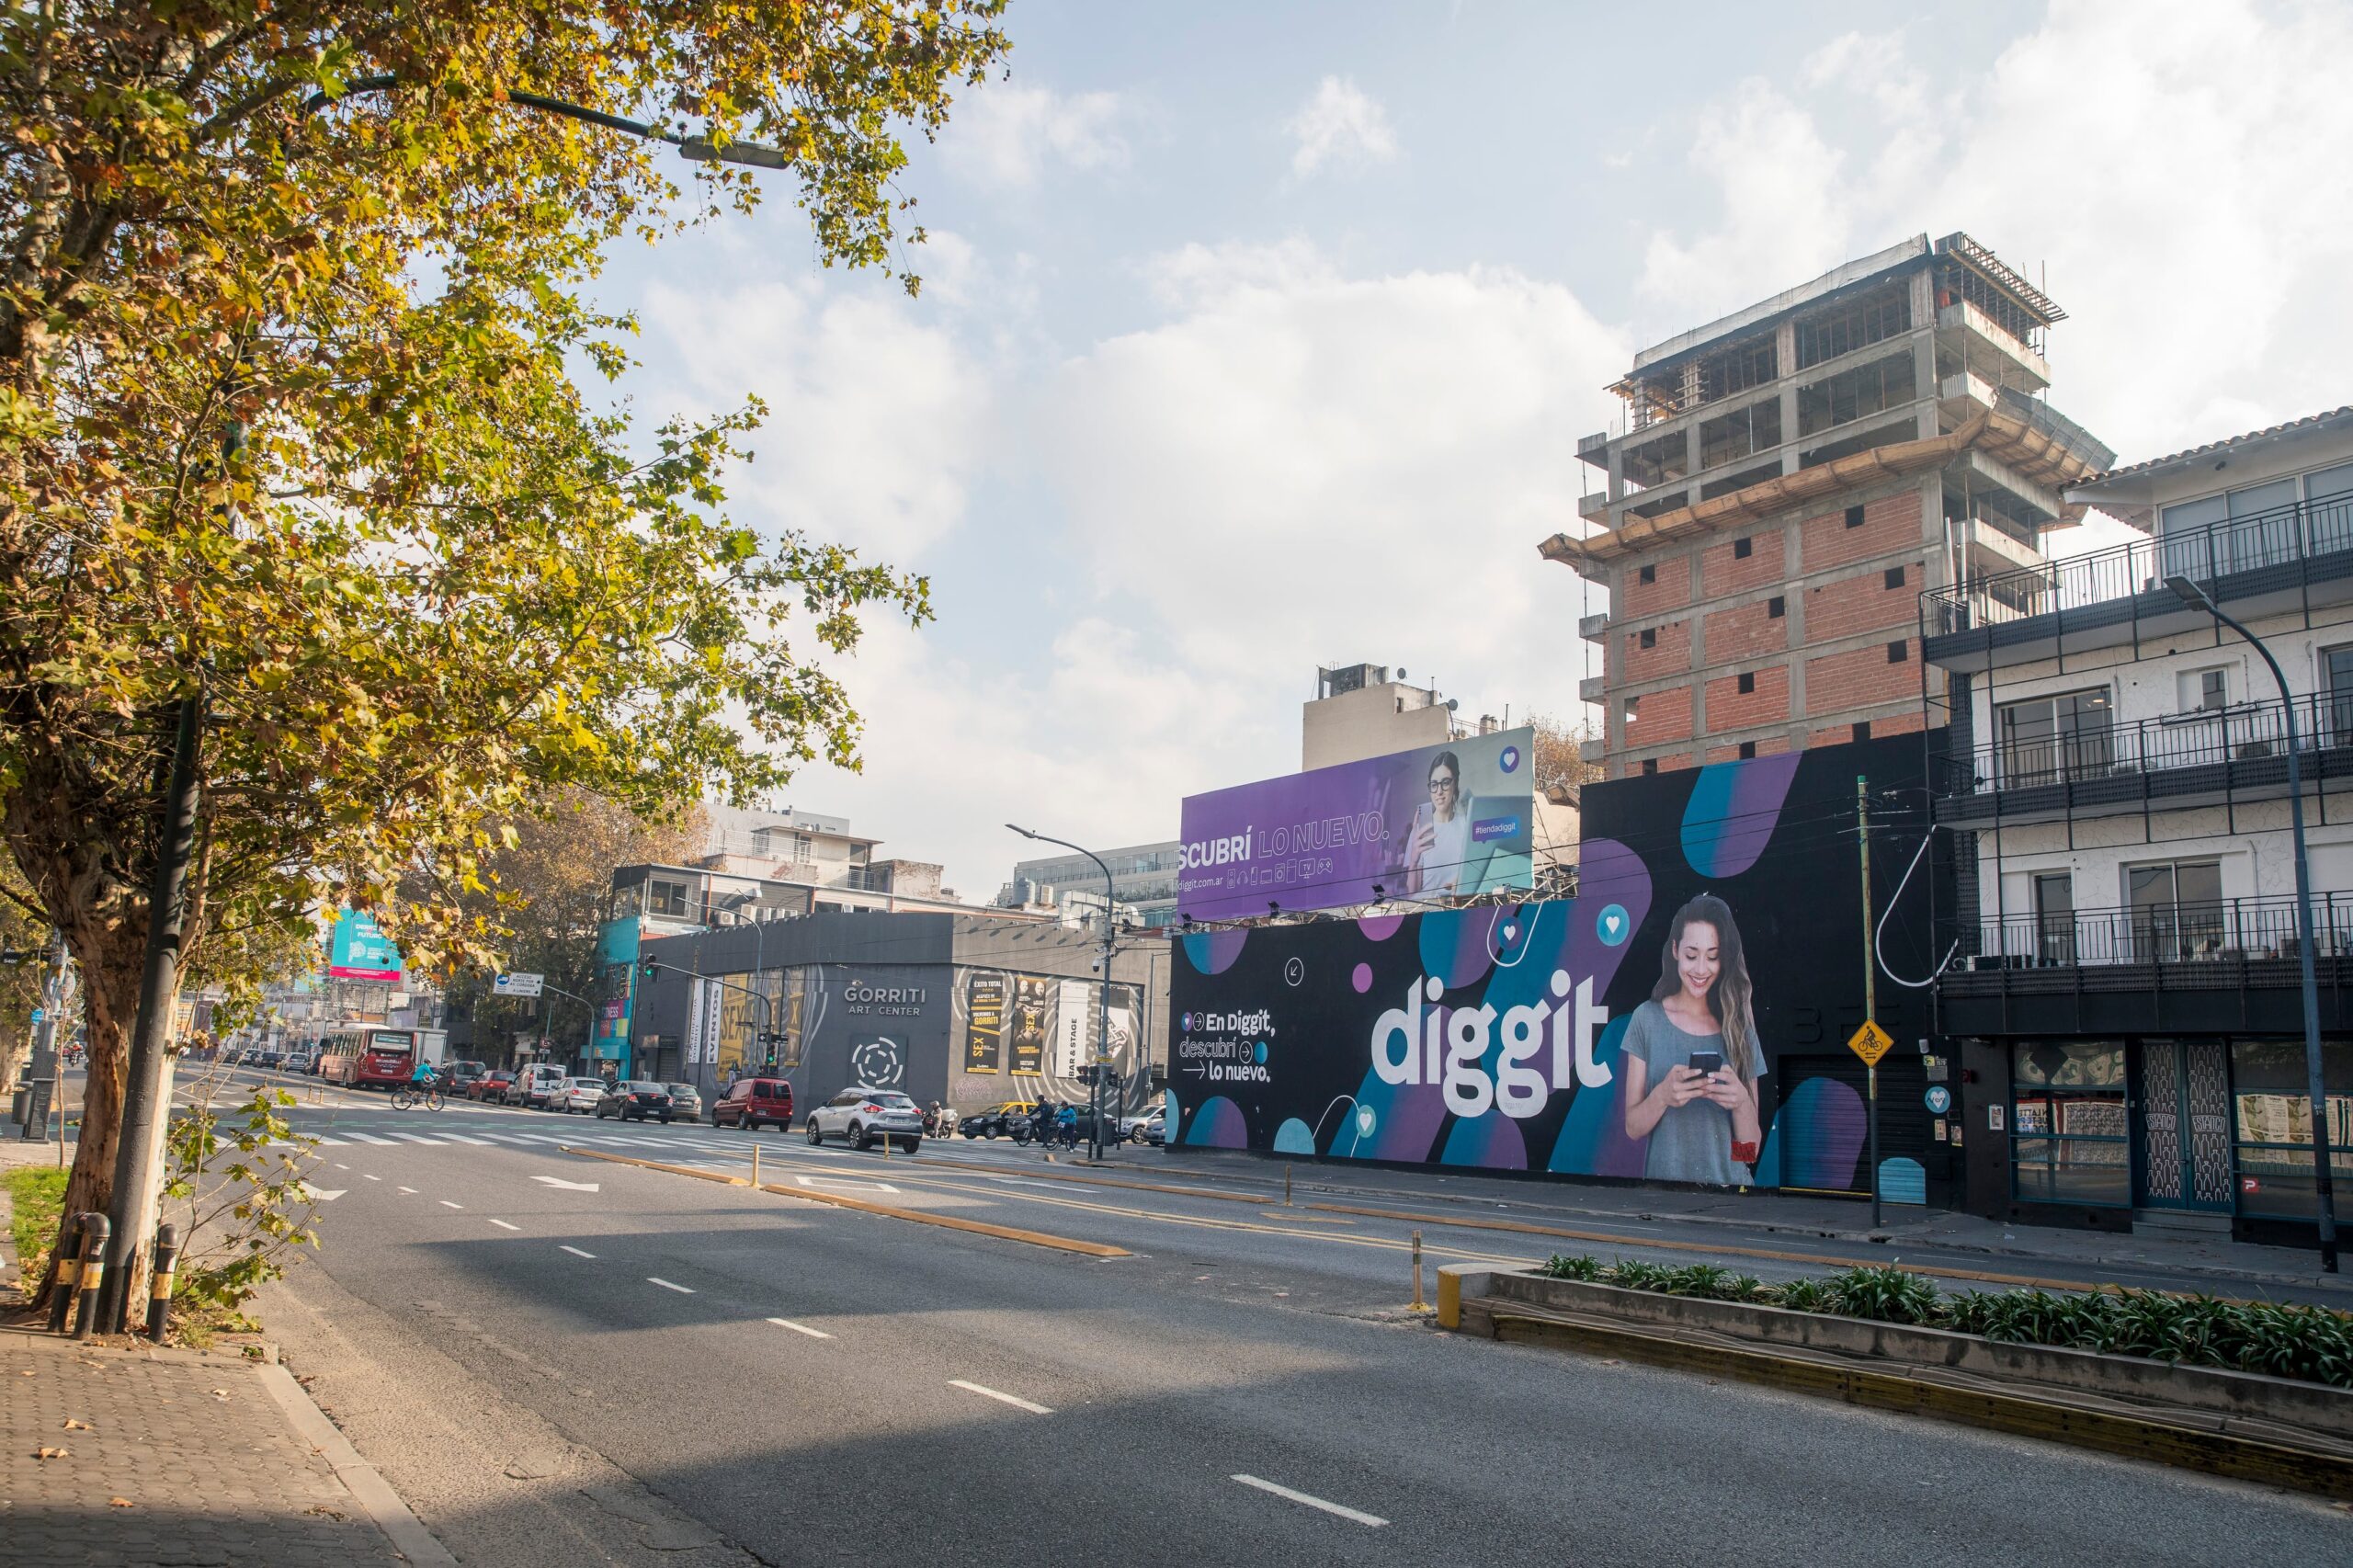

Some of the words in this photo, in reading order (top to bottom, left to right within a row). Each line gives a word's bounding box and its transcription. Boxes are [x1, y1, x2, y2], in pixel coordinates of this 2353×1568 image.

[1258, 827, 1289, 858] LO
[1293, 811, 1390, 853] NUEVO.
[1475, 822, 1516, 835] #tiendadiggit
[974, 980, 988, 988] ÉXITO
[844, 987, 926, 1004] GORRITI
[791, 1000, 799, 1025] X
[848, 1006, 871, 1015] ART
[879, 1006, 920, 1016] CENTER
[709, 989, 719, 1062] EVENTOS
[722, 1005, 745, 1040] SEX
[974, 1017, 999, 1026] GORRITI
[1026, 1014, 1035, 1032] SEX
[1206, 1014, 1224, 1030] En
[1228, 1009, 1276, 1037] Diggit,
[972, 1037, 983, 1057] SEX
[1070, 1049, 1076, 1057] &
[1179, 1036, 1237, 1057] descubrí
[1371, 969, 1613, 1119] diggit
[1210, 1060, 1222, 1081] lo
[1225, 1065, 1271, 1083] nuevo.
[2145, 1113, 2177, 1131] ESTANCO
[2192, 1115, 2226, 1132] ESTANCO
